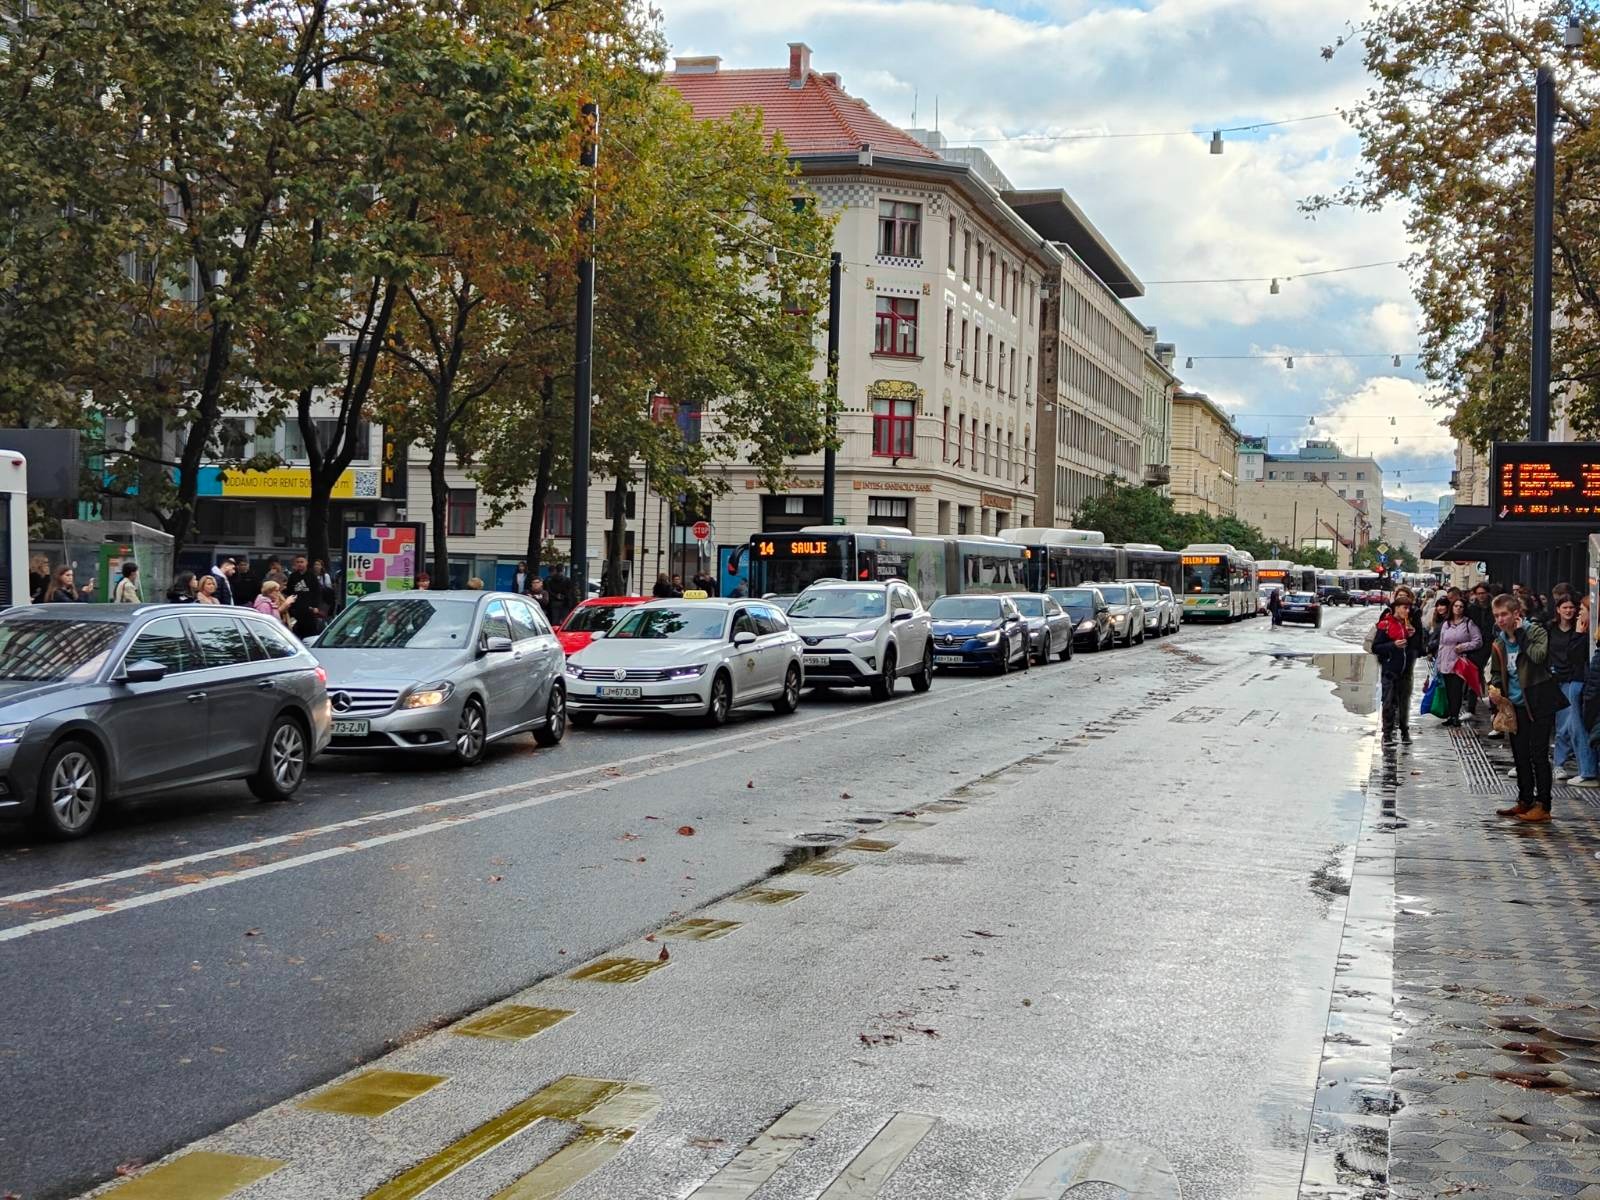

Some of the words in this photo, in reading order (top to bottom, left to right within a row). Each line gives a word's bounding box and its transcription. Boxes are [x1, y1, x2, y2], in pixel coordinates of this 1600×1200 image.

[263, 478, 277, 488] FOR
[280, 478, 297, 488] RENT
[694, 526, 709, 534] STOP
[760, 541, 775, 556] 14
